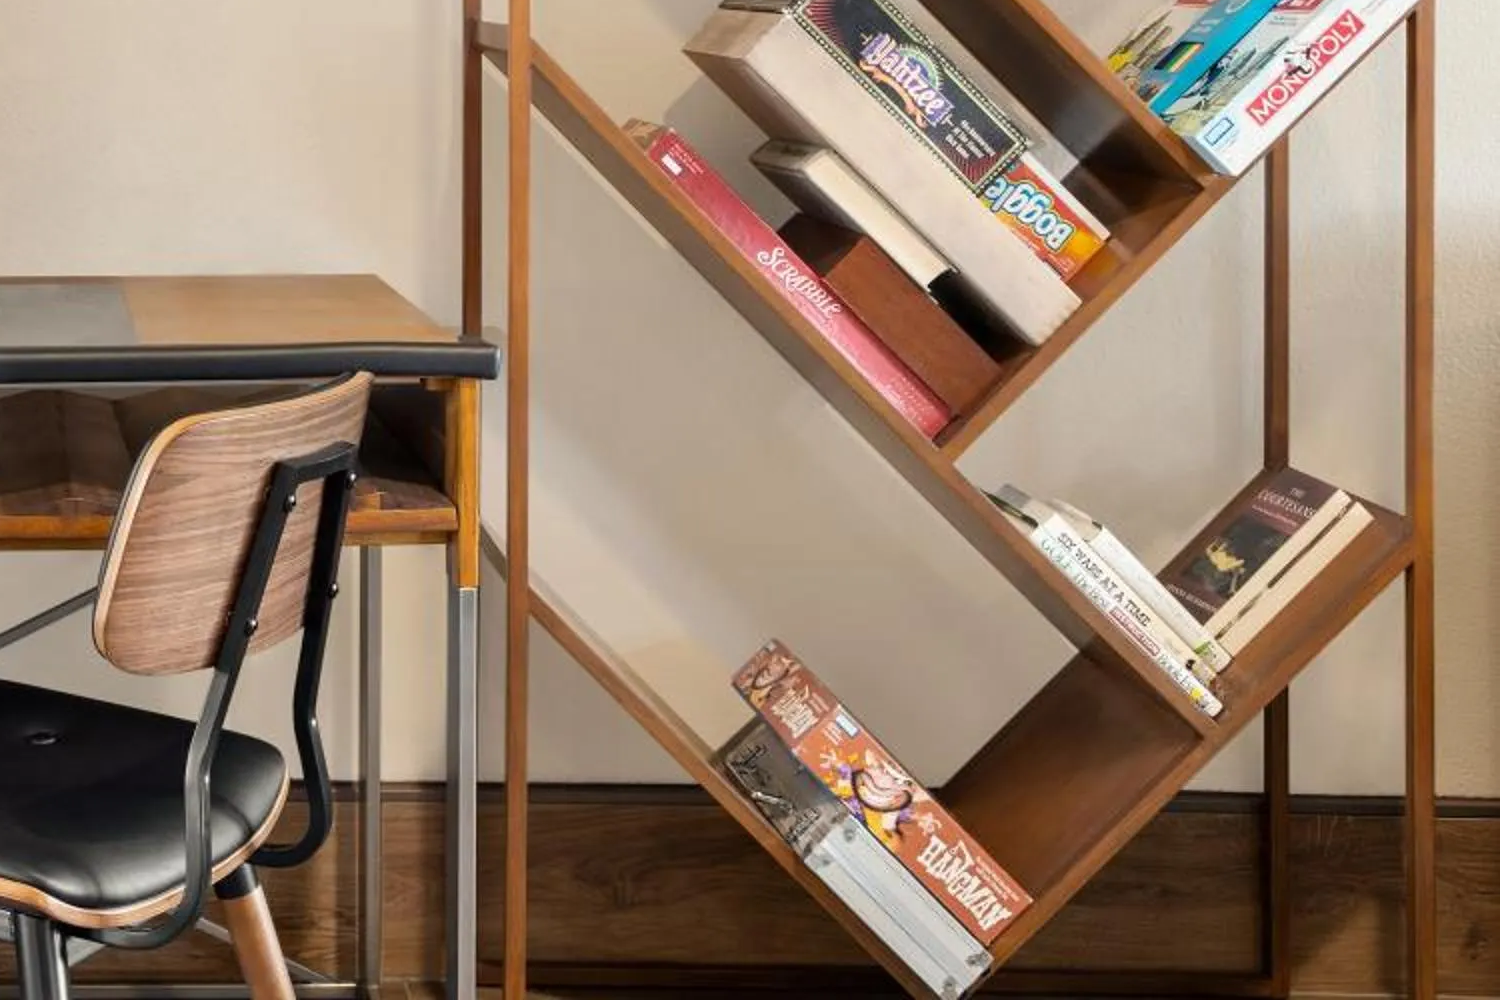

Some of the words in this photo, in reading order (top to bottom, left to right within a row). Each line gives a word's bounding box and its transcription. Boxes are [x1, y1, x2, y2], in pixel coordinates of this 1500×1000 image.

[986, 178, 1073, 249] Boggle
[1057, 532, 1077, 552] SIX
[1100, 576, 1119, 594] AT
[1113, 590, 1125, 603] A
[1124, 599, 1151, 627] TIME
[916, 835, 1012, 931] HANGMAN
